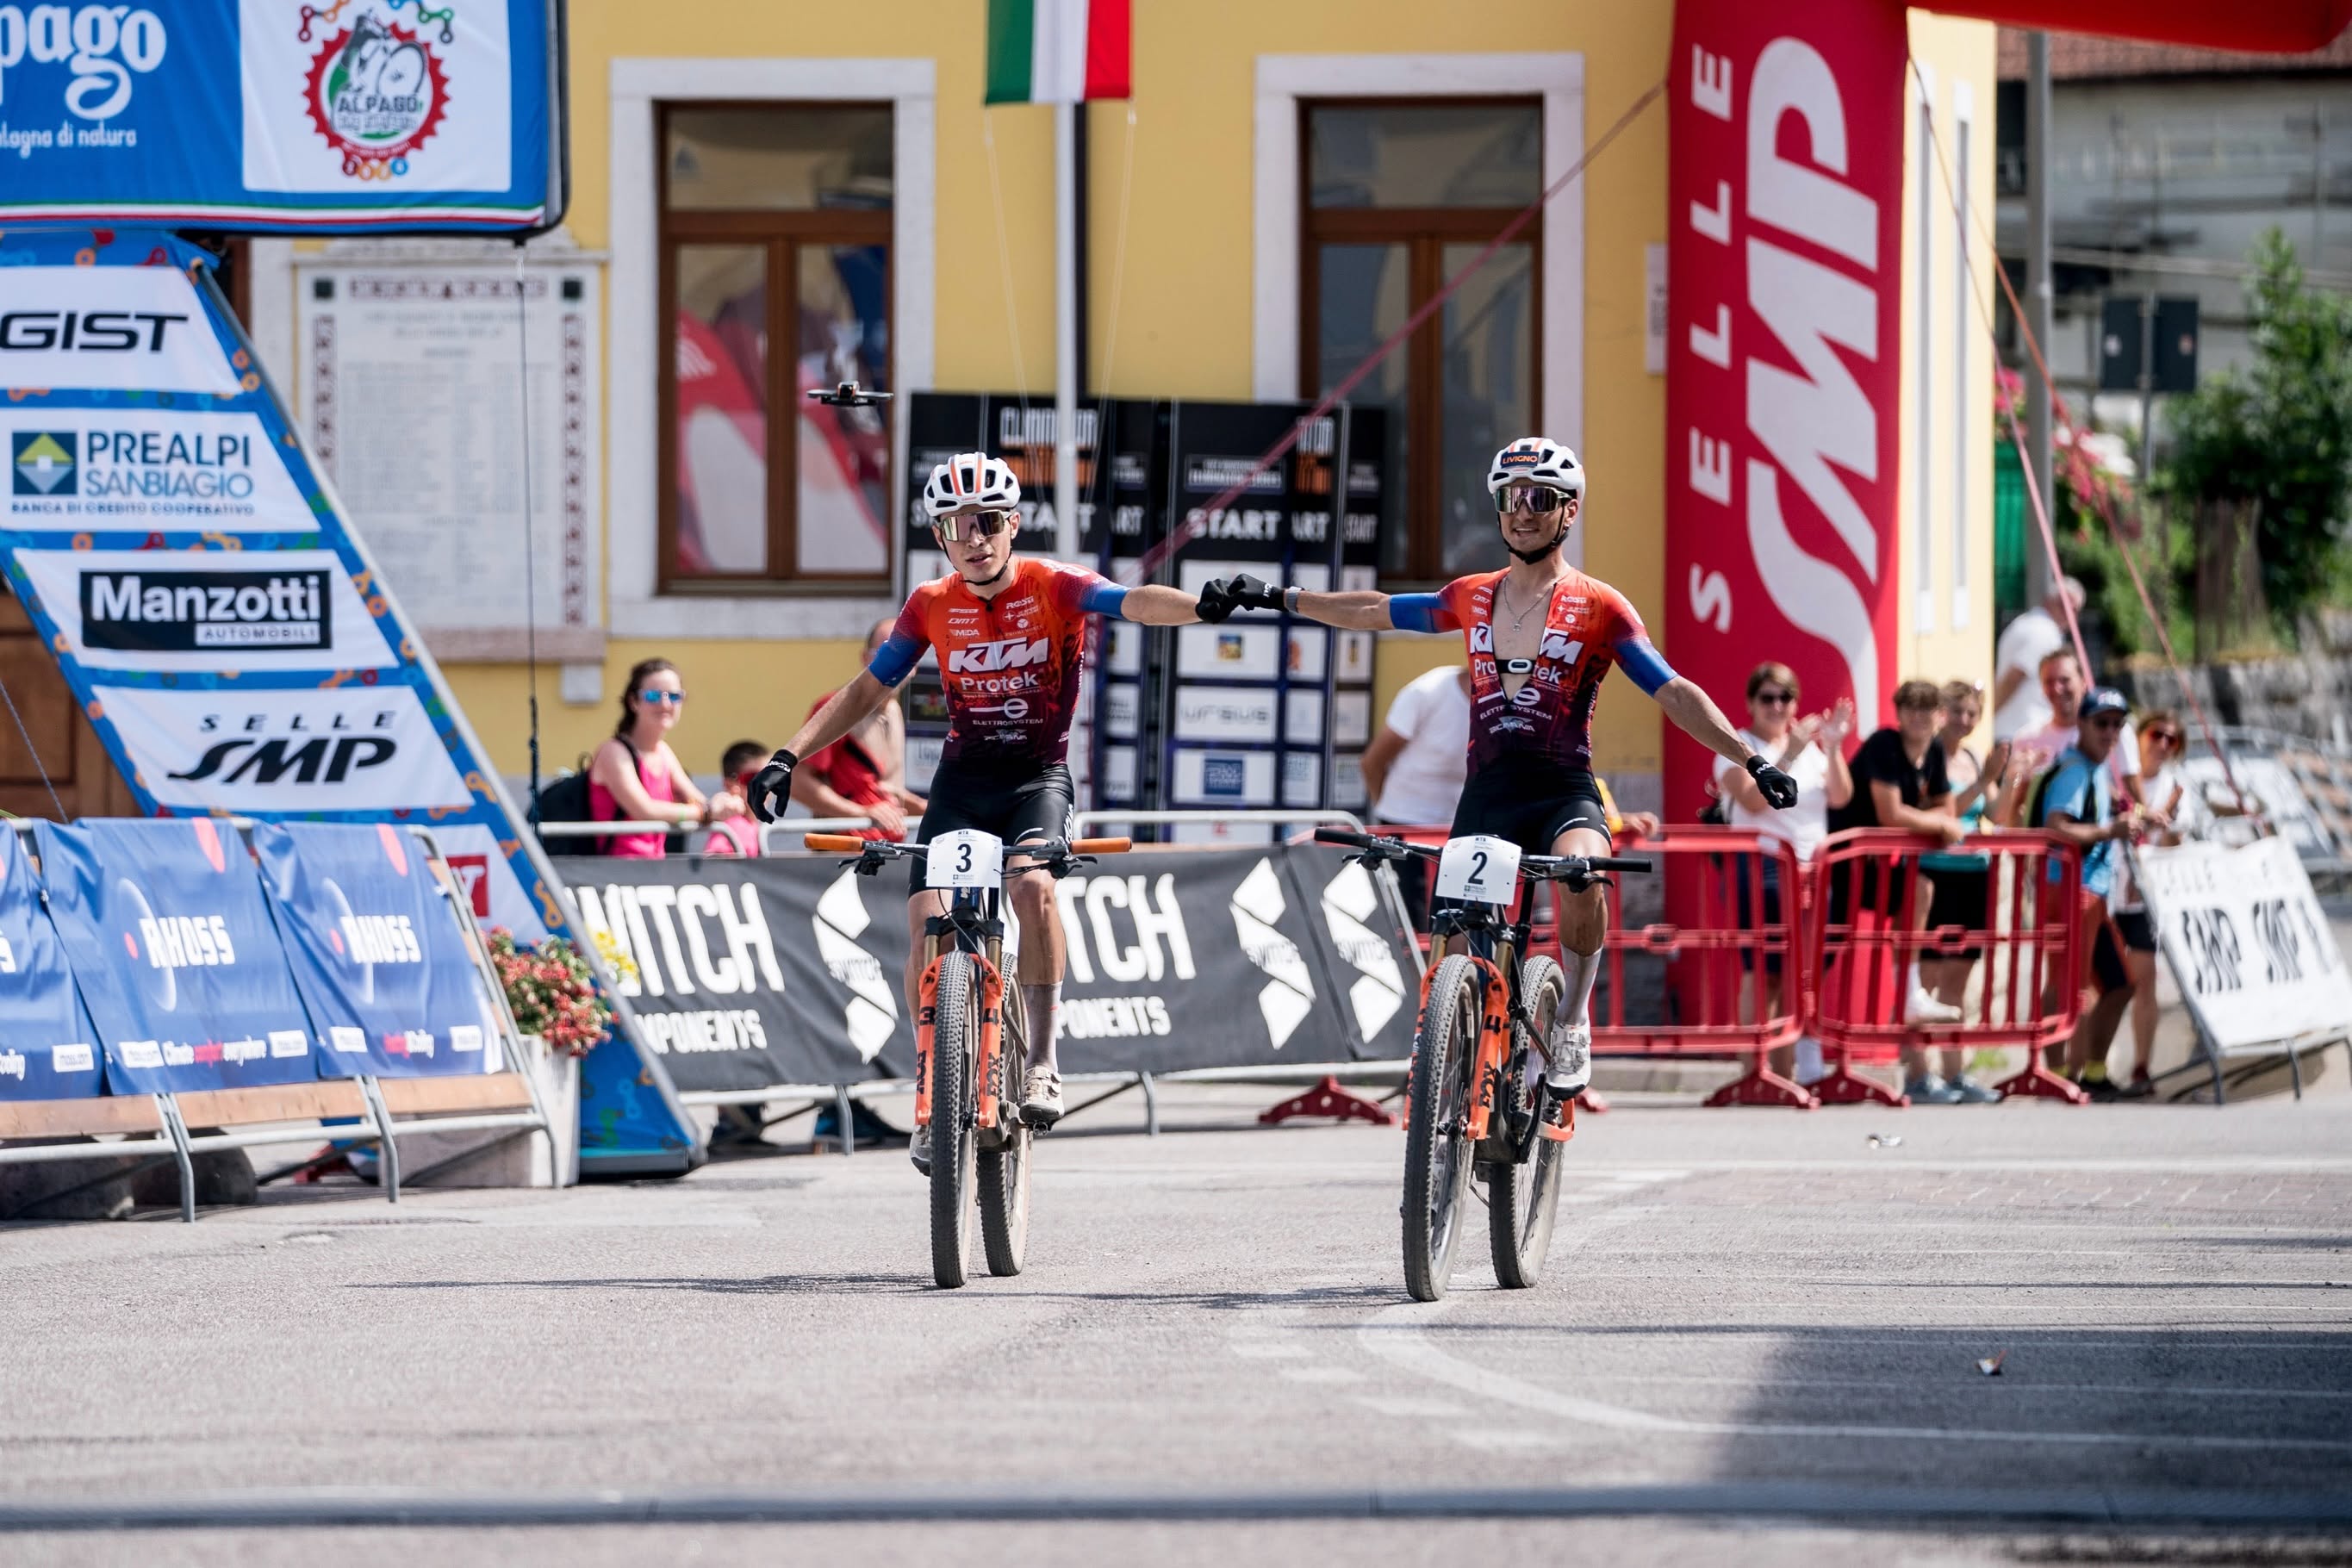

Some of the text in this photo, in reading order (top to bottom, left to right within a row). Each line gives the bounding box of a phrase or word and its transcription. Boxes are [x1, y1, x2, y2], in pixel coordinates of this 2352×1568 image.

[339, 94, 417, 113] ALPAGO
[57, 120, 74, 146] di
[0, 313, 188, 351] GIST
[1689, 44, 1733, 633] SELLE
[1746, 37, 1878, 743] SMP
[88, 432, 250, 467] PREALPI
[87, 471, 253, 498] SANBIAGIO
[12, 502, 254, 515] BANCA DI CREDITO COOPERATIVO
[1185, 507, 1281, 540] START
[91, 575, 320, 621] Manzotti
[204, 627, 316, 638] AUTOMOBILI
[949, 637, 1049, 673] KTM
[960, 671, 1038, 693] Protek
[200, 711, 396, 732] SELLE
[167, 737, 397, 785] SMP
[955, 843, 972, 873] 3
[1468, 851, 1488, 885] 2
[1478, 1061, 1496, 1108] FOX
